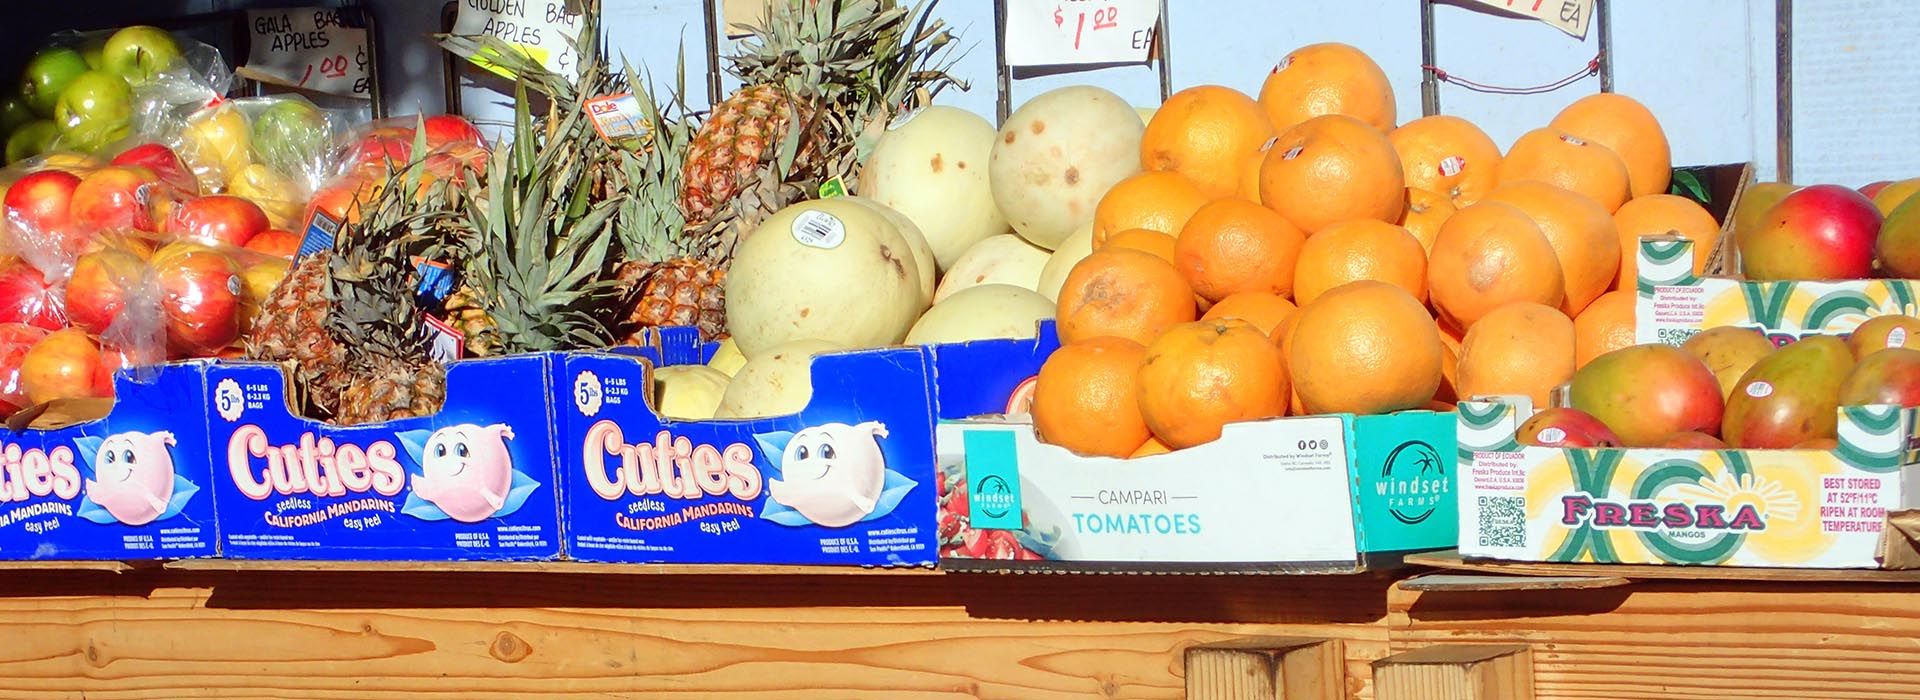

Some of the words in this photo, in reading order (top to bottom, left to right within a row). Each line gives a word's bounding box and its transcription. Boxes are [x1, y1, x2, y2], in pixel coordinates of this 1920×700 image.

[255, 14, 292, 35] GALA
[482, 18, 541, 45] APPLES
[272, 31, 330, 52] APPLES
[616, 378, 626, 386] LBS
[606, 396, 621, 404] BAGS
[228, 424, 405, 500] Cuties
[584, 419, 762, 501] Cuties
[1376, 476, 1448, 496] windset
[1823, 478, 1845, 489] BEST
[1848, 478, 1881, 489] STORED
[277, 497, 311, 512] seedless
[1098, 490, 1167, 505] CAMPARI
[1826, 492, 1838, 503] AT
[10, 502, 72, 523] MANDARINS
[264, 510, 327, 528] CALIFORNIA
[327, 498, 396, 519] MANDARINS
[628, 499, 665, 514] seedless
[1561, 495, 1765, 530] FRESKA
[1820, 506, 1845, 517] RIPEN
[1848, 507, 1858, 518] AT
[344, 517, 363, 531] easy
[616, 512, 682, 531] CALIFORNIA
[682, 502, 754, 522] MANDARINS
[1072, 513, 1201, 534] TOMATOES
[25, 521, 42, 535] easy
[700, 521, 720, 535] easy
[1822, 520, 1883, 532] TEMPERATURE
[1668, 531, 1706, 539] MANGOS
